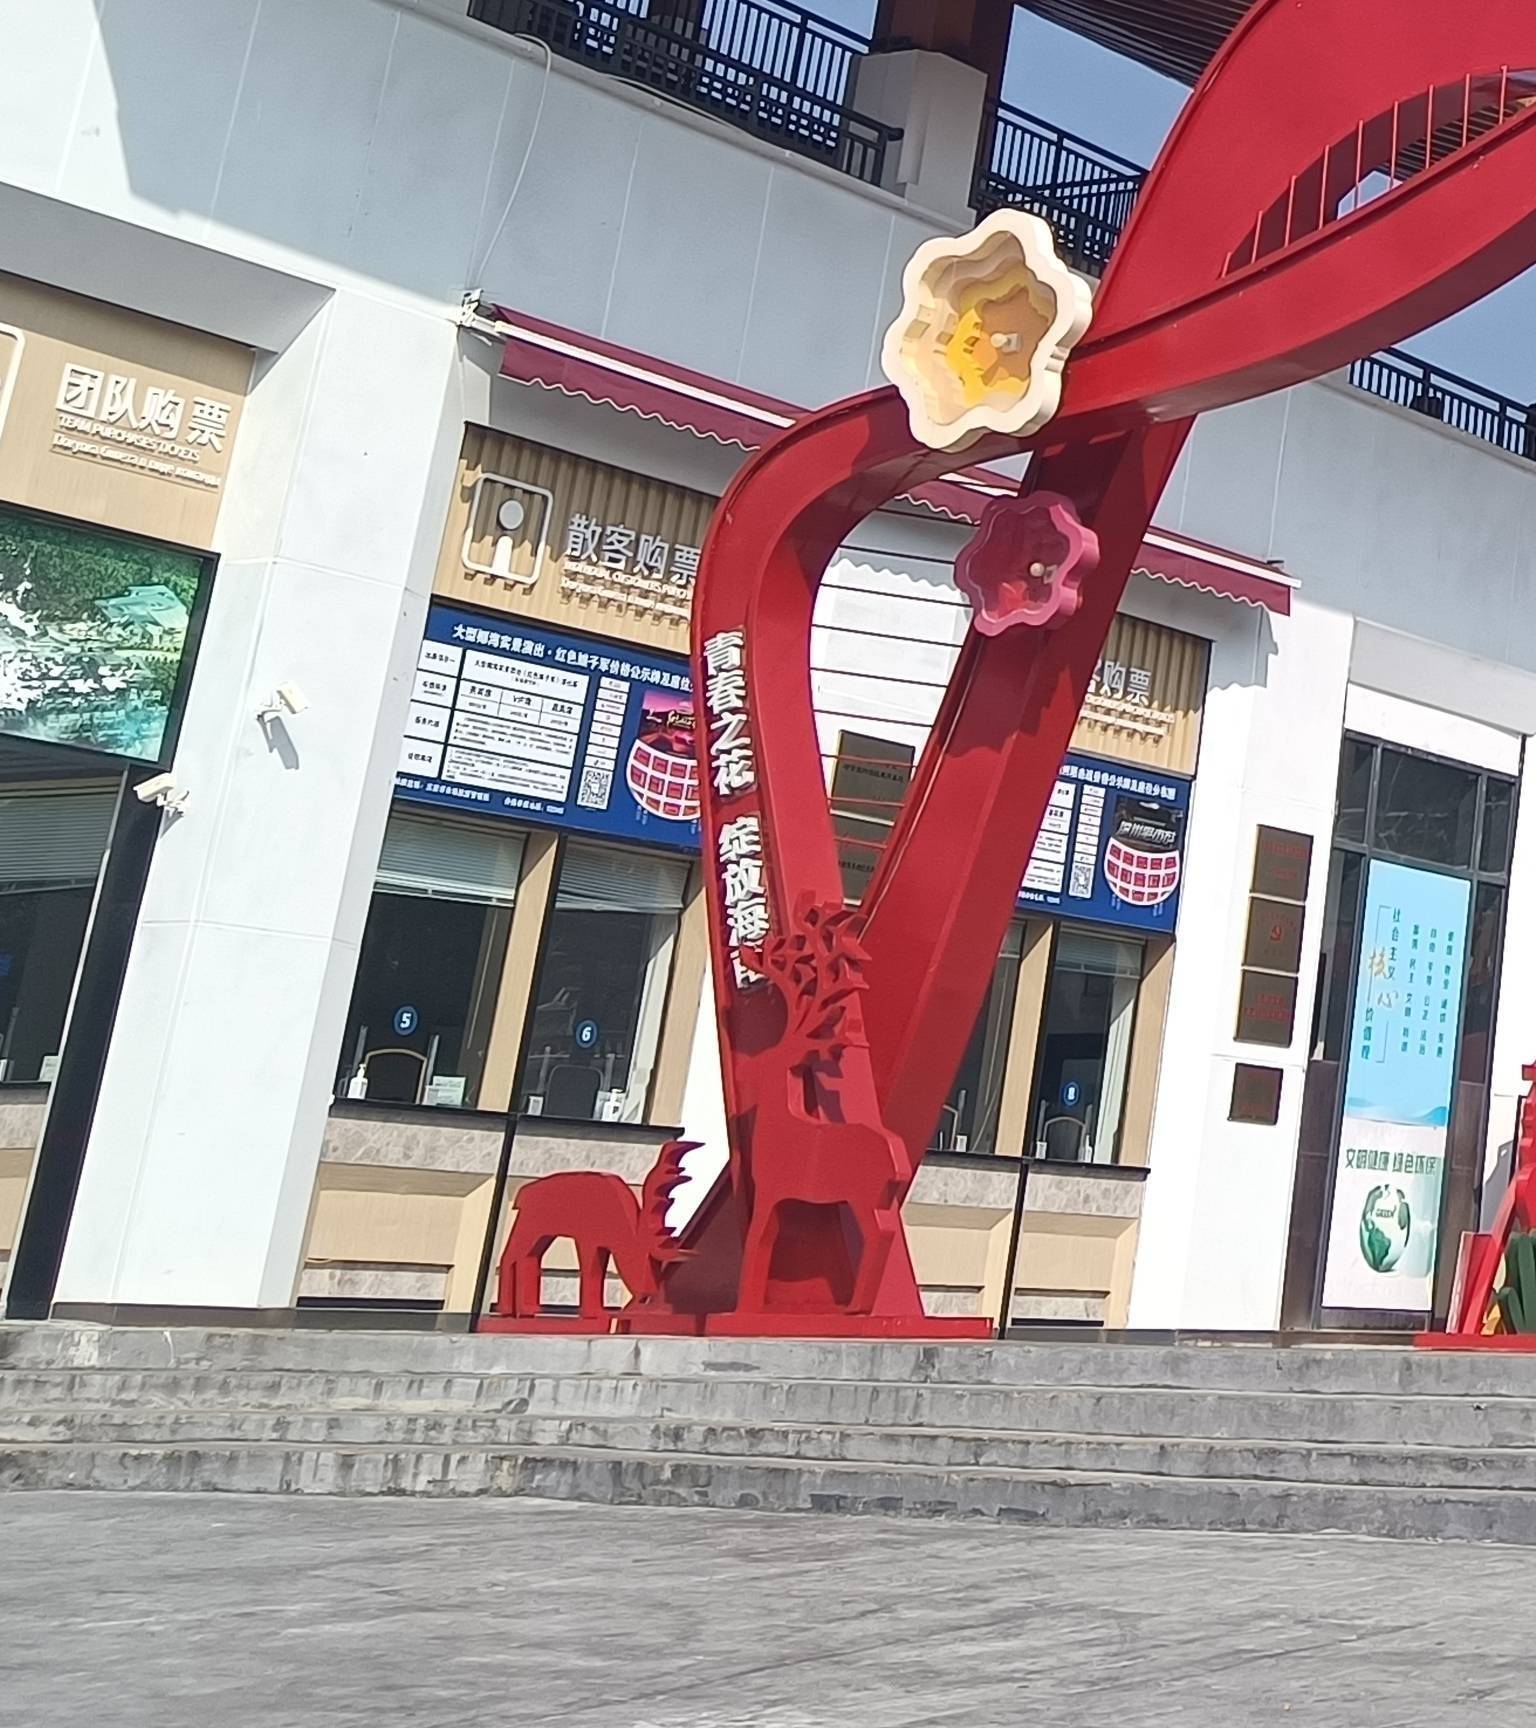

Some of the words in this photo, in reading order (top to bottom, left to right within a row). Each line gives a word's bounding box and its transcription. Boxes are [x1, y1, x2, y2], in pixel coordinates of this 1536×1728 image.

[55, 363, 232, 452] 团队购票
[566, 513, 702, 586] 散客购票
[703, 632, 755, 796] 青春之花
[400, 1013, 412, 1029] 5
[581, 1026, 592, 1043] 6
